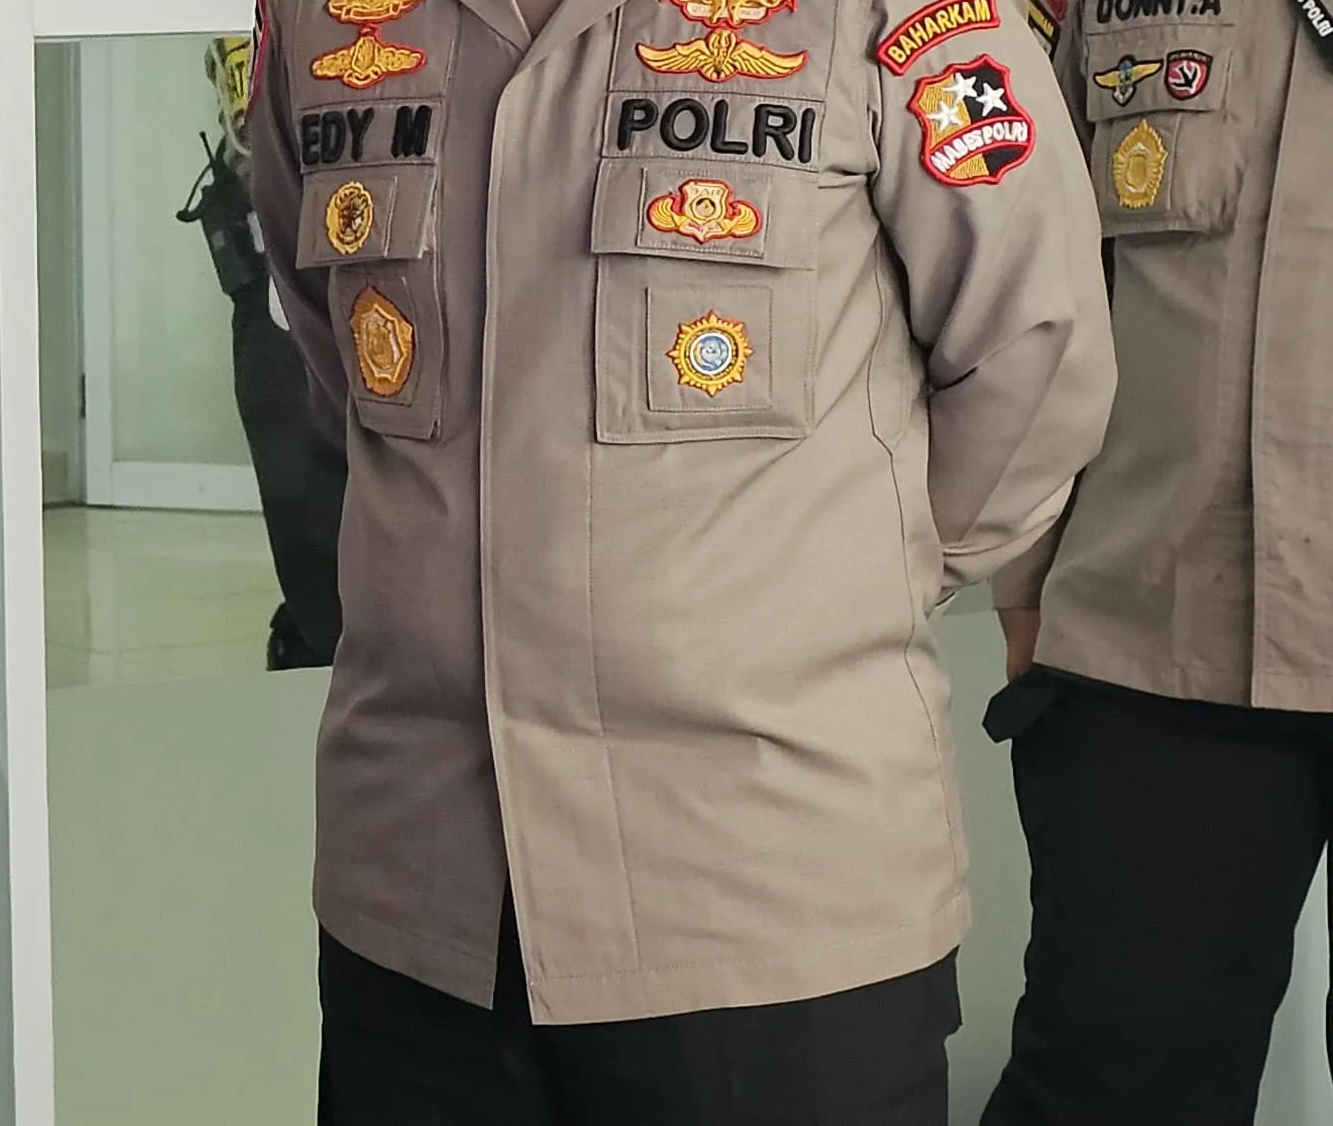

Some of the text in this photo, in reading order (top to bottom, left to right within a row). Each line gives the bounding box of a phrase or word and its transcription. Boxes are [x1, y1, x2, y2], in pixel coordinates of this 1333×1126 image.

[301, 104, 433, 166] EDY M
[617, 98, 817, 164] POLRI
[984, 121, 1029, 145] POLRI
